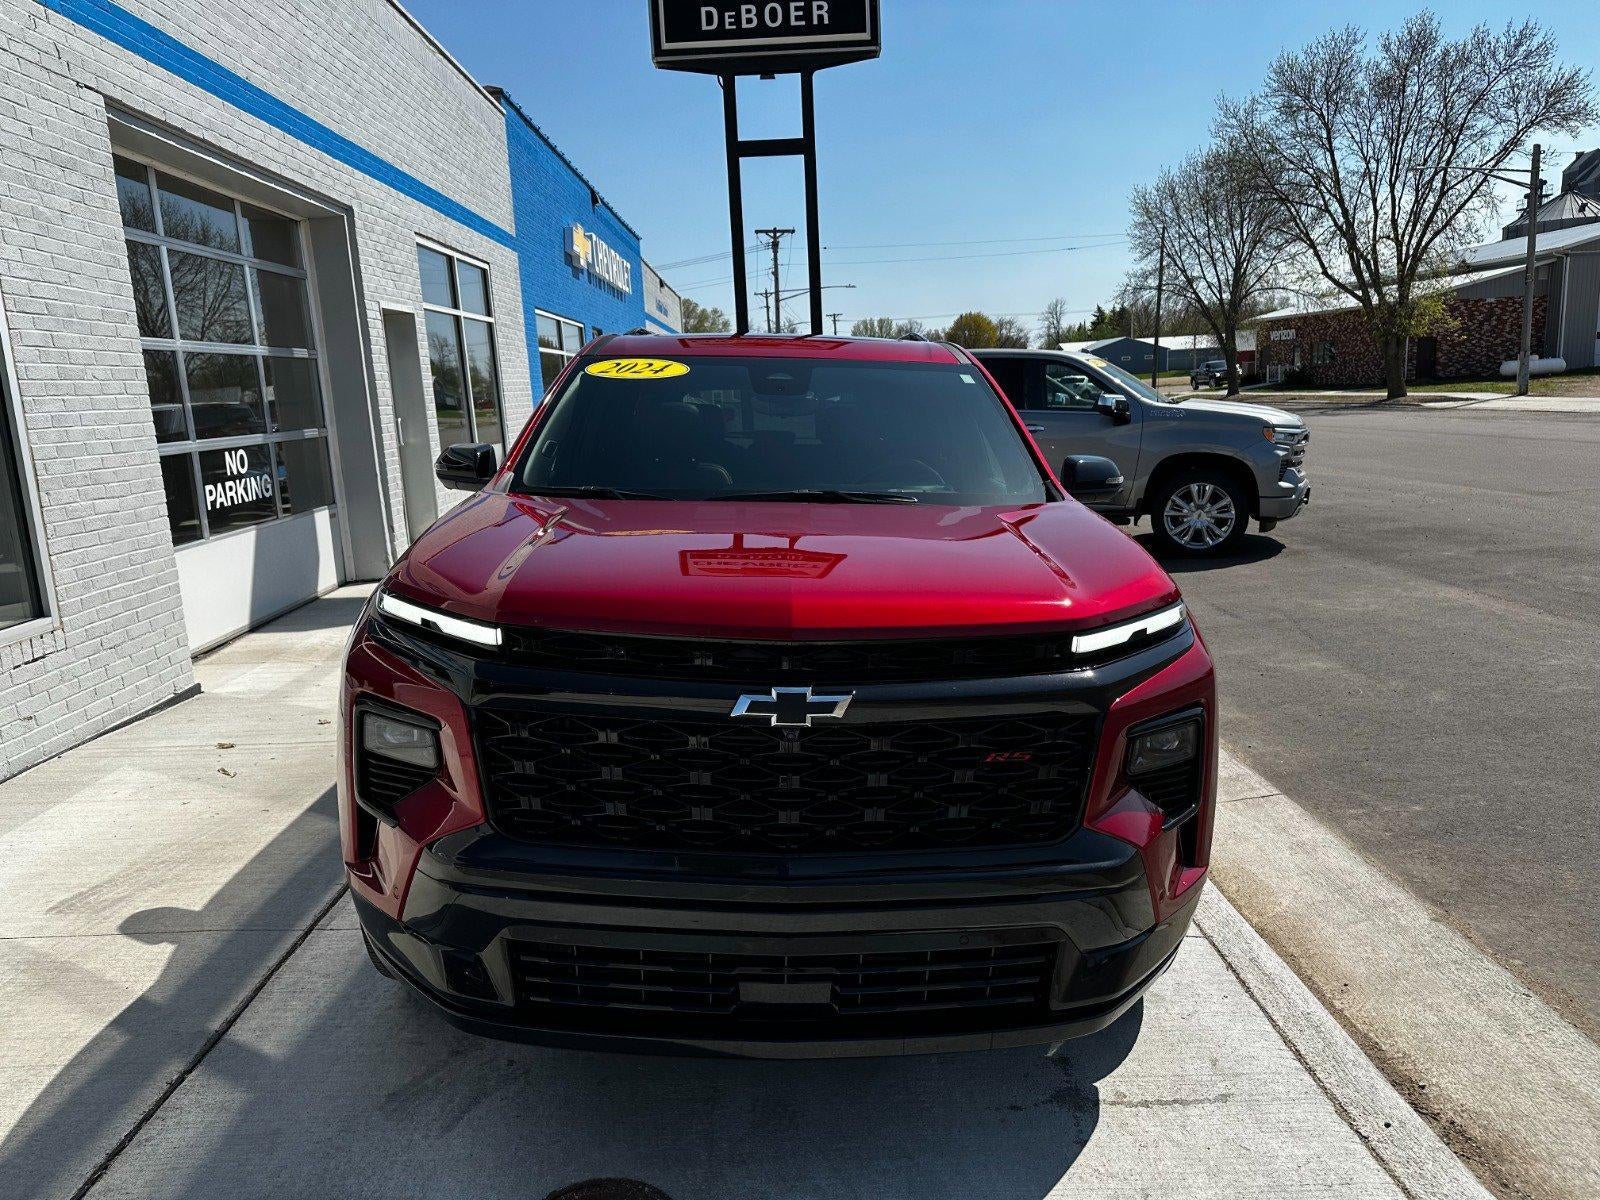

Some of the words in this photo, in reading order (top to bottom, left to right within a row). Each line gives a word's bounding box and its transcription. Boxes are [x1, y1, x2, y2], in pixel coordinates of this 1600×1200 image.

[1269, 328, 1296, 341] verizon
[597, 362, 673, 374] 2024
[224, 449, 248, 476] NO
[204, 474, 272, 511] PARKING
